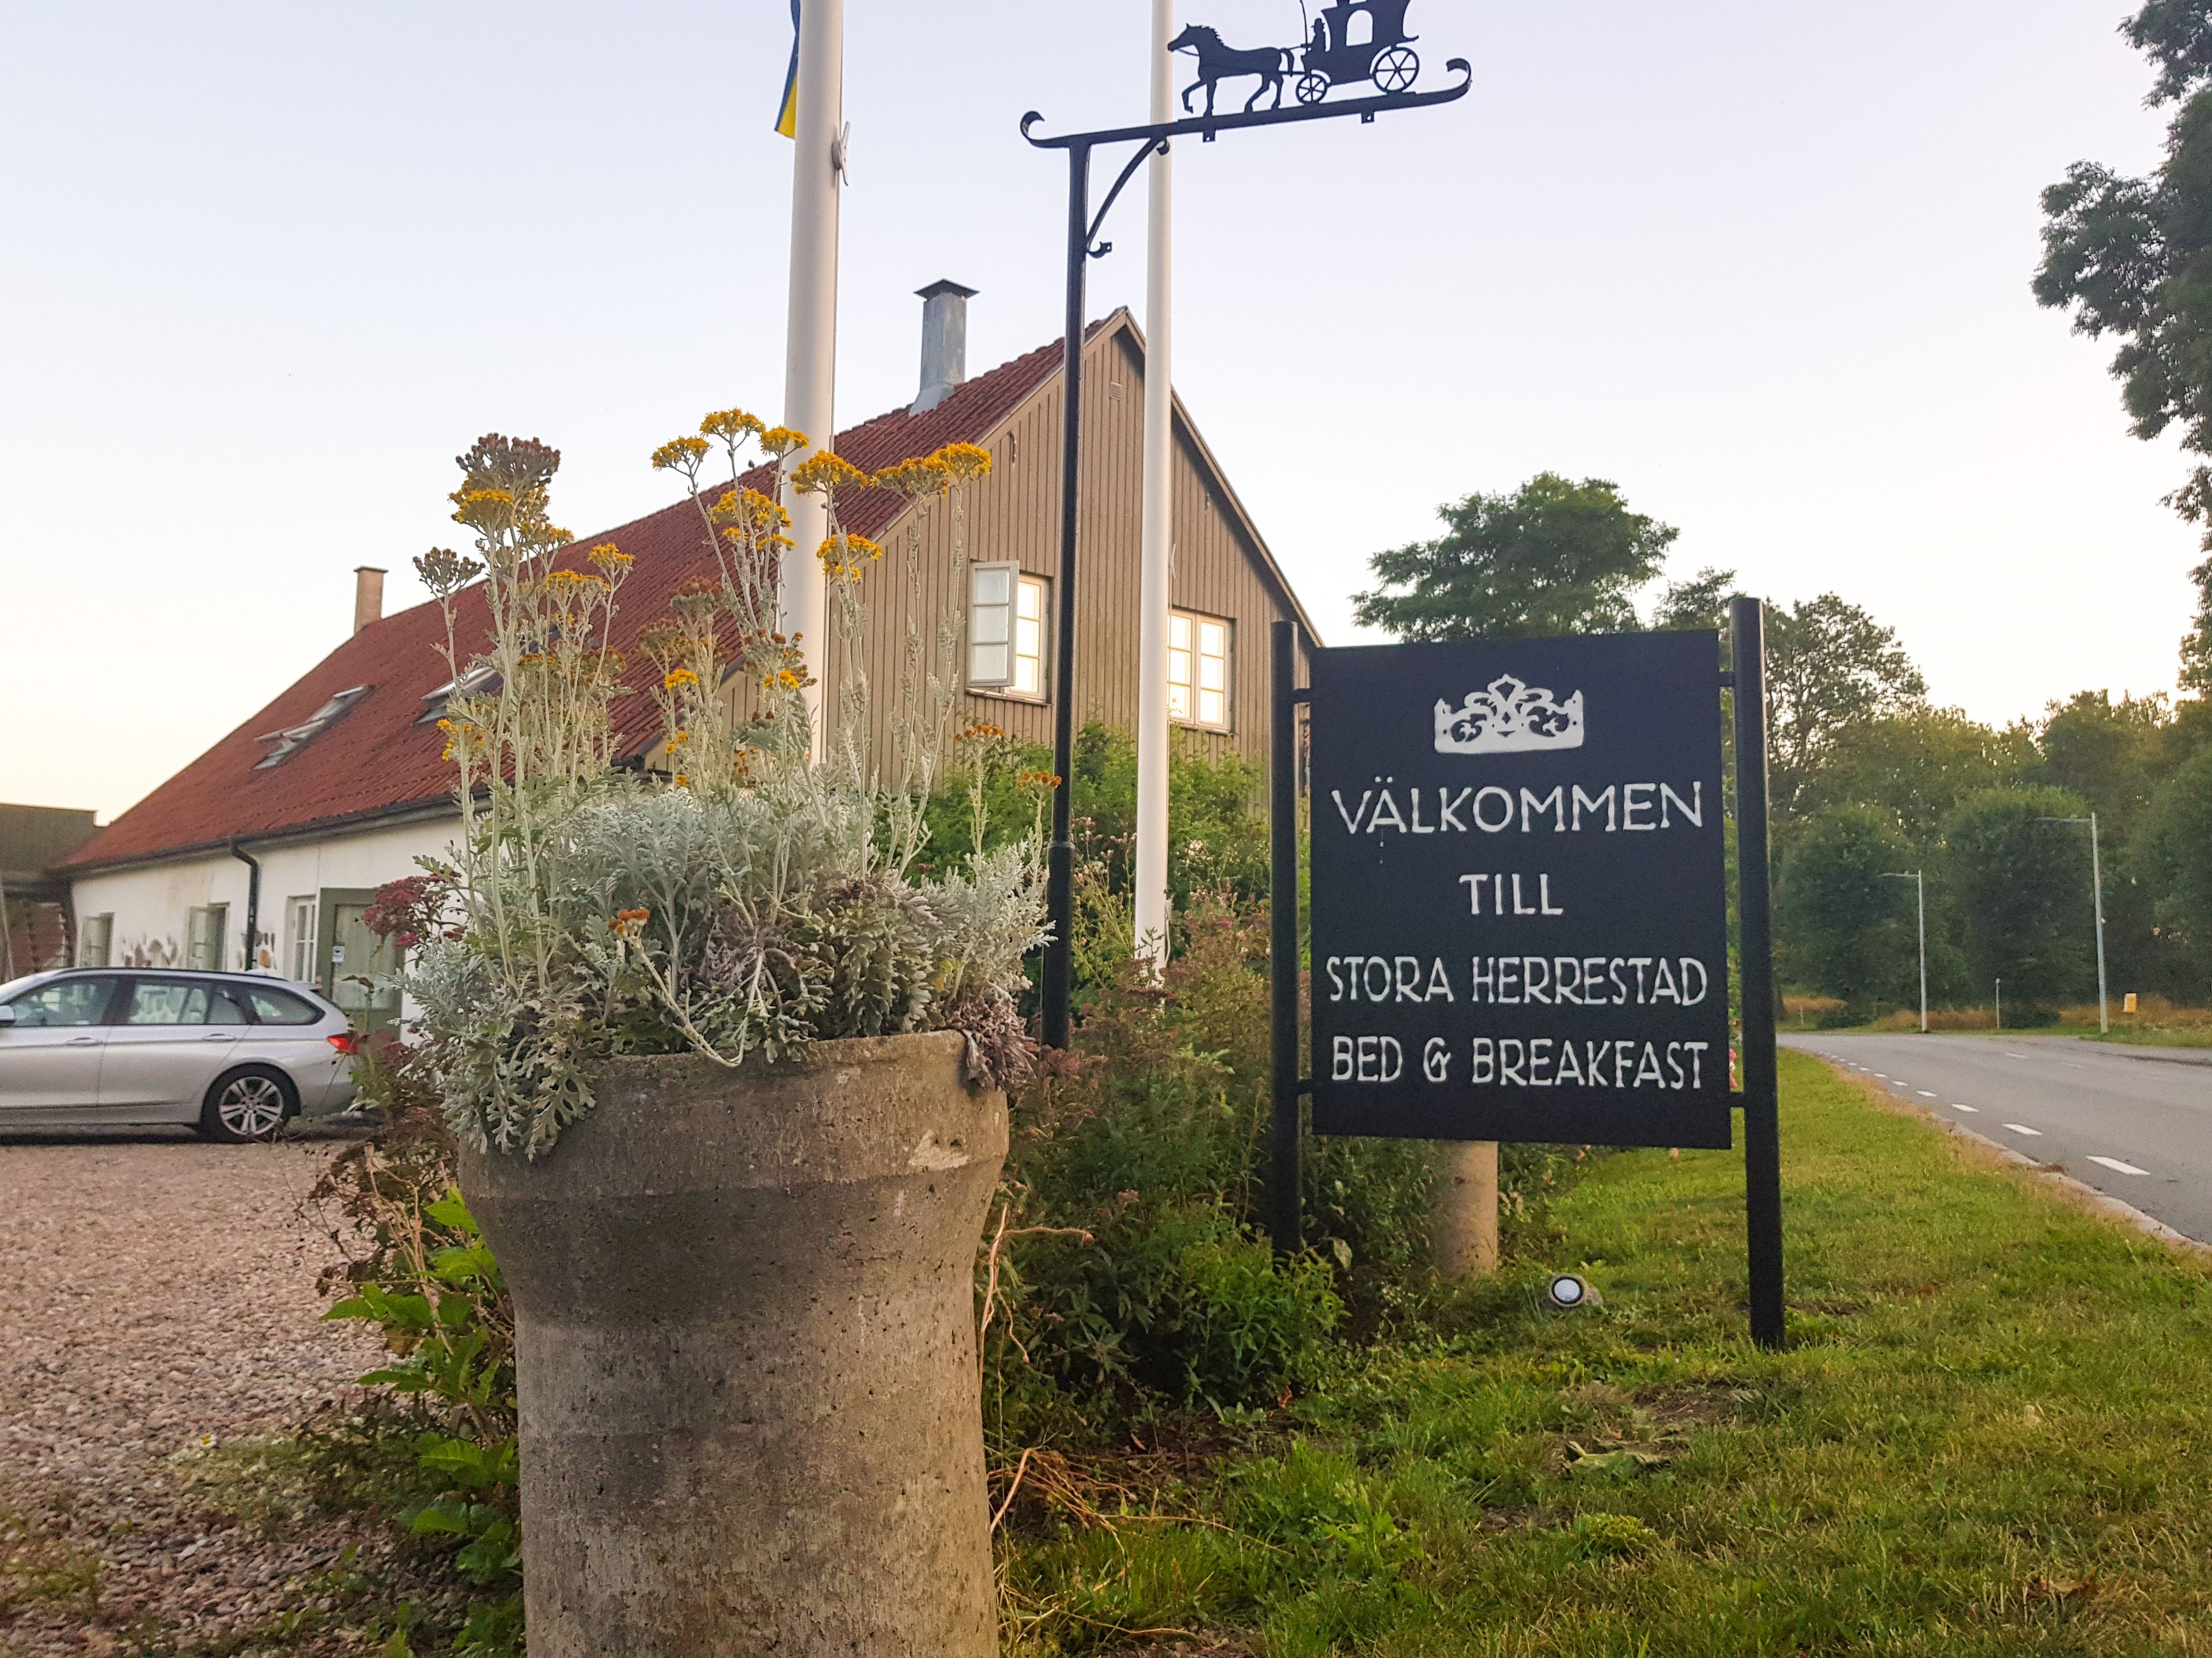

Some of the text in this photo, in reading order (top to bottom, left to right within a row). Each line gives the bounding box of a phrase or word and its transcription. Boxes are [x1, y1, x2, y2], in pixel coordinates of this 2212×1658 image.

[1331, 776, 1703, 834] VÄLKOMMEN
[1459, 873, 1564, 916] TILL
[1326, 955, 1707, 1007] STORA HERRESTAD
[1331, 1035, 1403, 1082] BED
[1471, 1037, 1709, 1090] BREAKFAST
